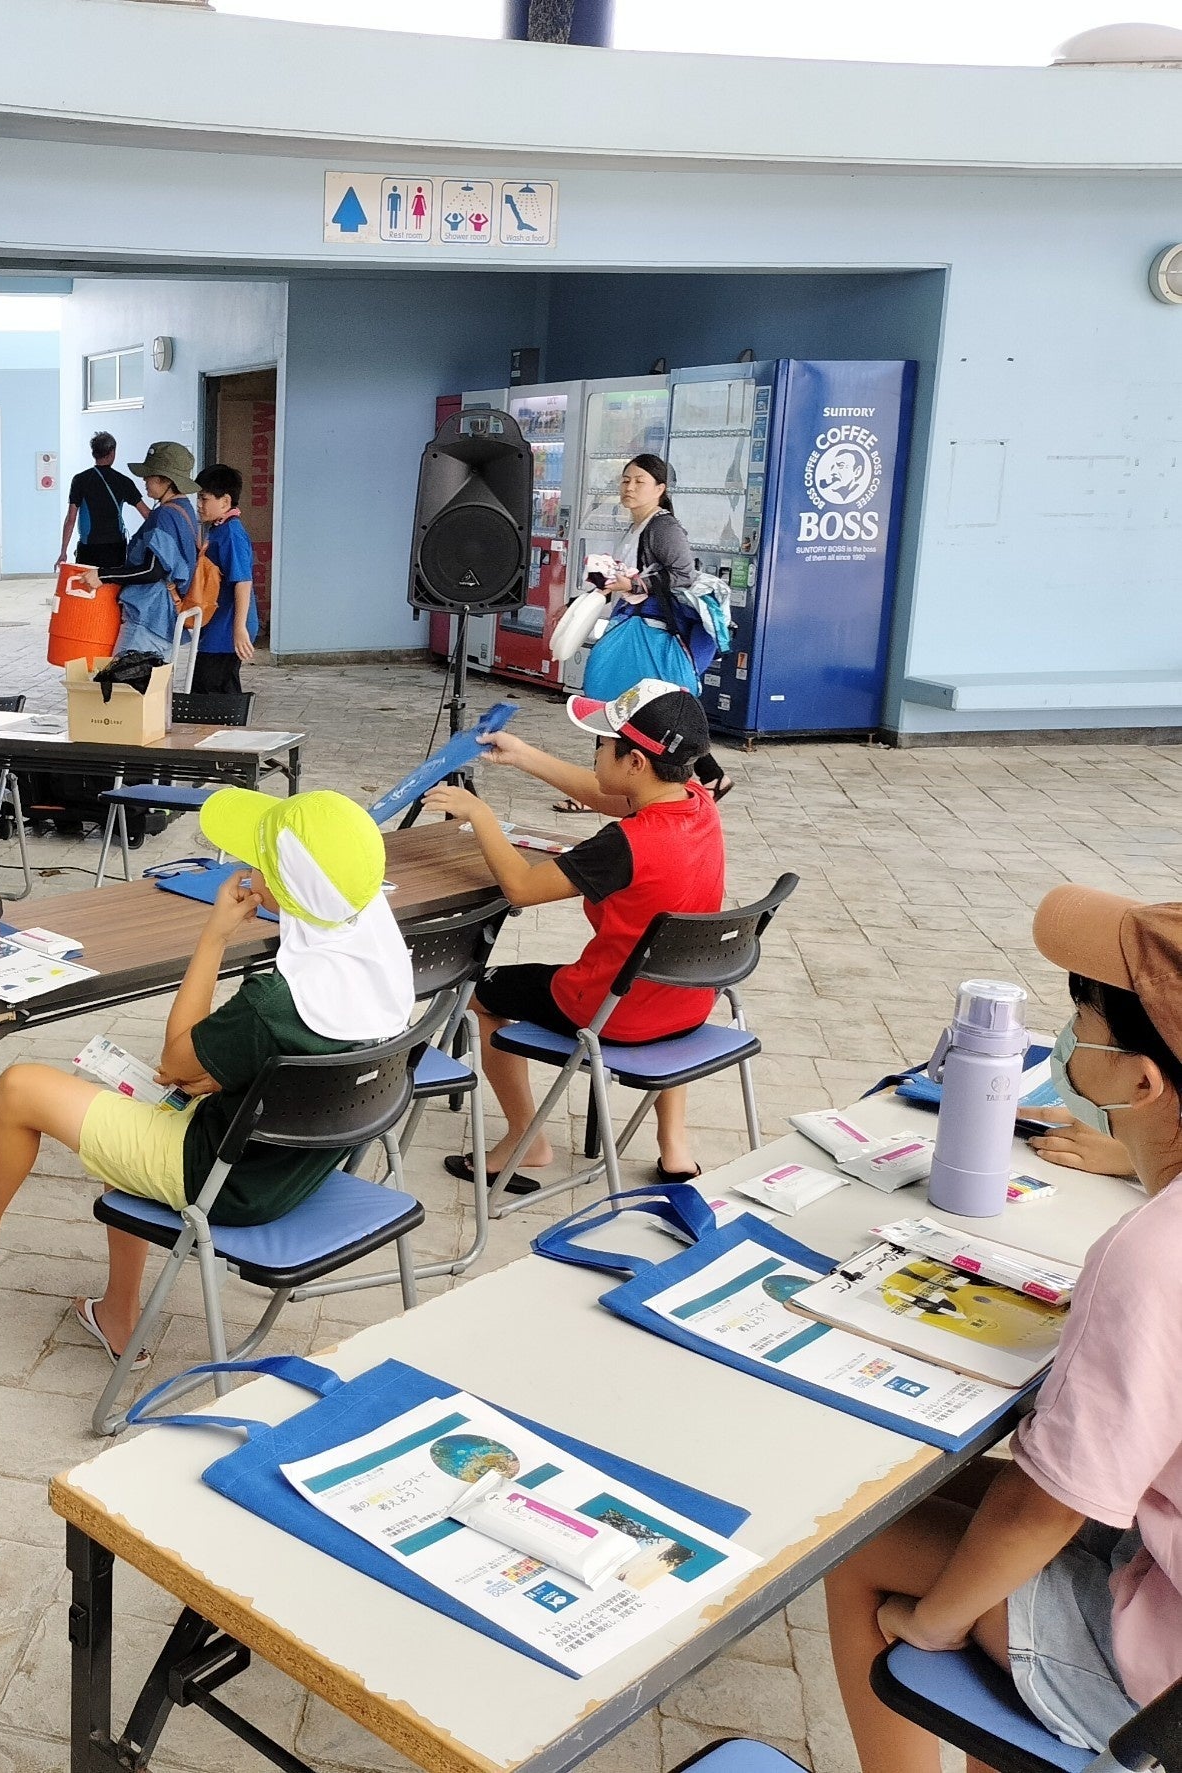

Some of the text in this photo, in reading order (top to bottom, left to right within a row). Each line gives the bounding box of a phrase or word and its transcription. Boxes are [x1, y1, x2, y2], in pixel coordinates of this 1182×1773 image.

[389, 230, 404, 239] Rest
[444, 233, 468, 241] Shower
[506, 234, 524, 242] Wash
[532, 234, 545, 242] foot
[823, 407, 875, 418] SUNTORY
[815, 425, 878, 451] COFFEE
[251, 401, 275, 507] Marin
[804, 450, 826, 510] BOSS COFFEE
[856, 450, 882, 510] BOSS COFFEE
[797, 511, 879, 542] BOSS
[796, 545, 827, 554] SUNTORY
[828, 545, 846, 553] BOSS
[852, 545, 862, 553] the
[863, 545, 877, 553] boss
[805, 554, 812, 562] of
[812, 554, 827, 562] them
[827, 553, 836, 561] all
[347, 1471, 432, 1514] 海の化について
